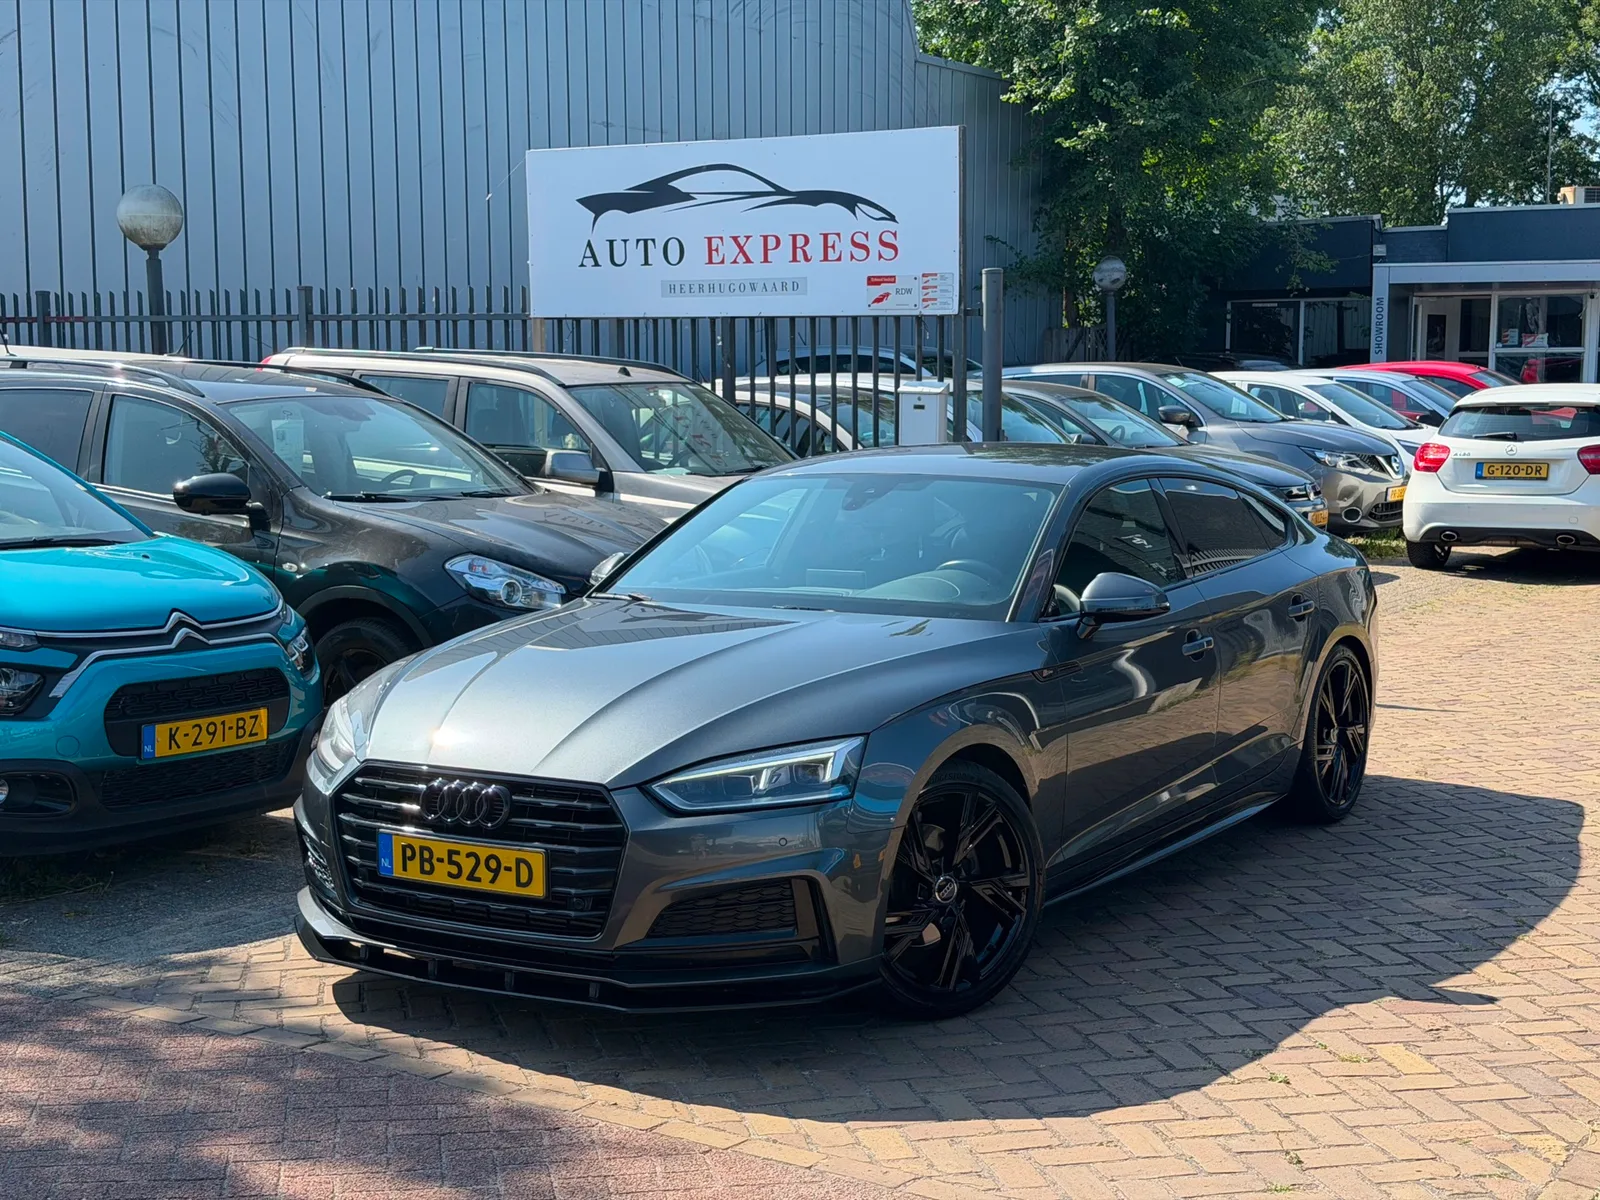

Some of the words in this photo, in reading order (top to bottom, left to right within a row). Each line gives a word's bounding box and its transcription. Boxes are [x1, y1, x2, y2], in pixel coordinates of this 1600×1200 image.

[578, 236, 685, 268] AUTO
[704, 230, 899, 265] EXPRESS
[668, 281, 800, 294] HEERHUGOWAARD
[895, 287, 913, 296] RDW
[1374, 297, 1385, 355] SHOWROOM
[1487, 464, 1543, 476] G-120-DR
[168, 714, 259, 751] K-291-BZ
[144, 744, 154, 753] NL
[381, 857, 392, 869] NL
[400, 842, 534, 889] PB-529-D
